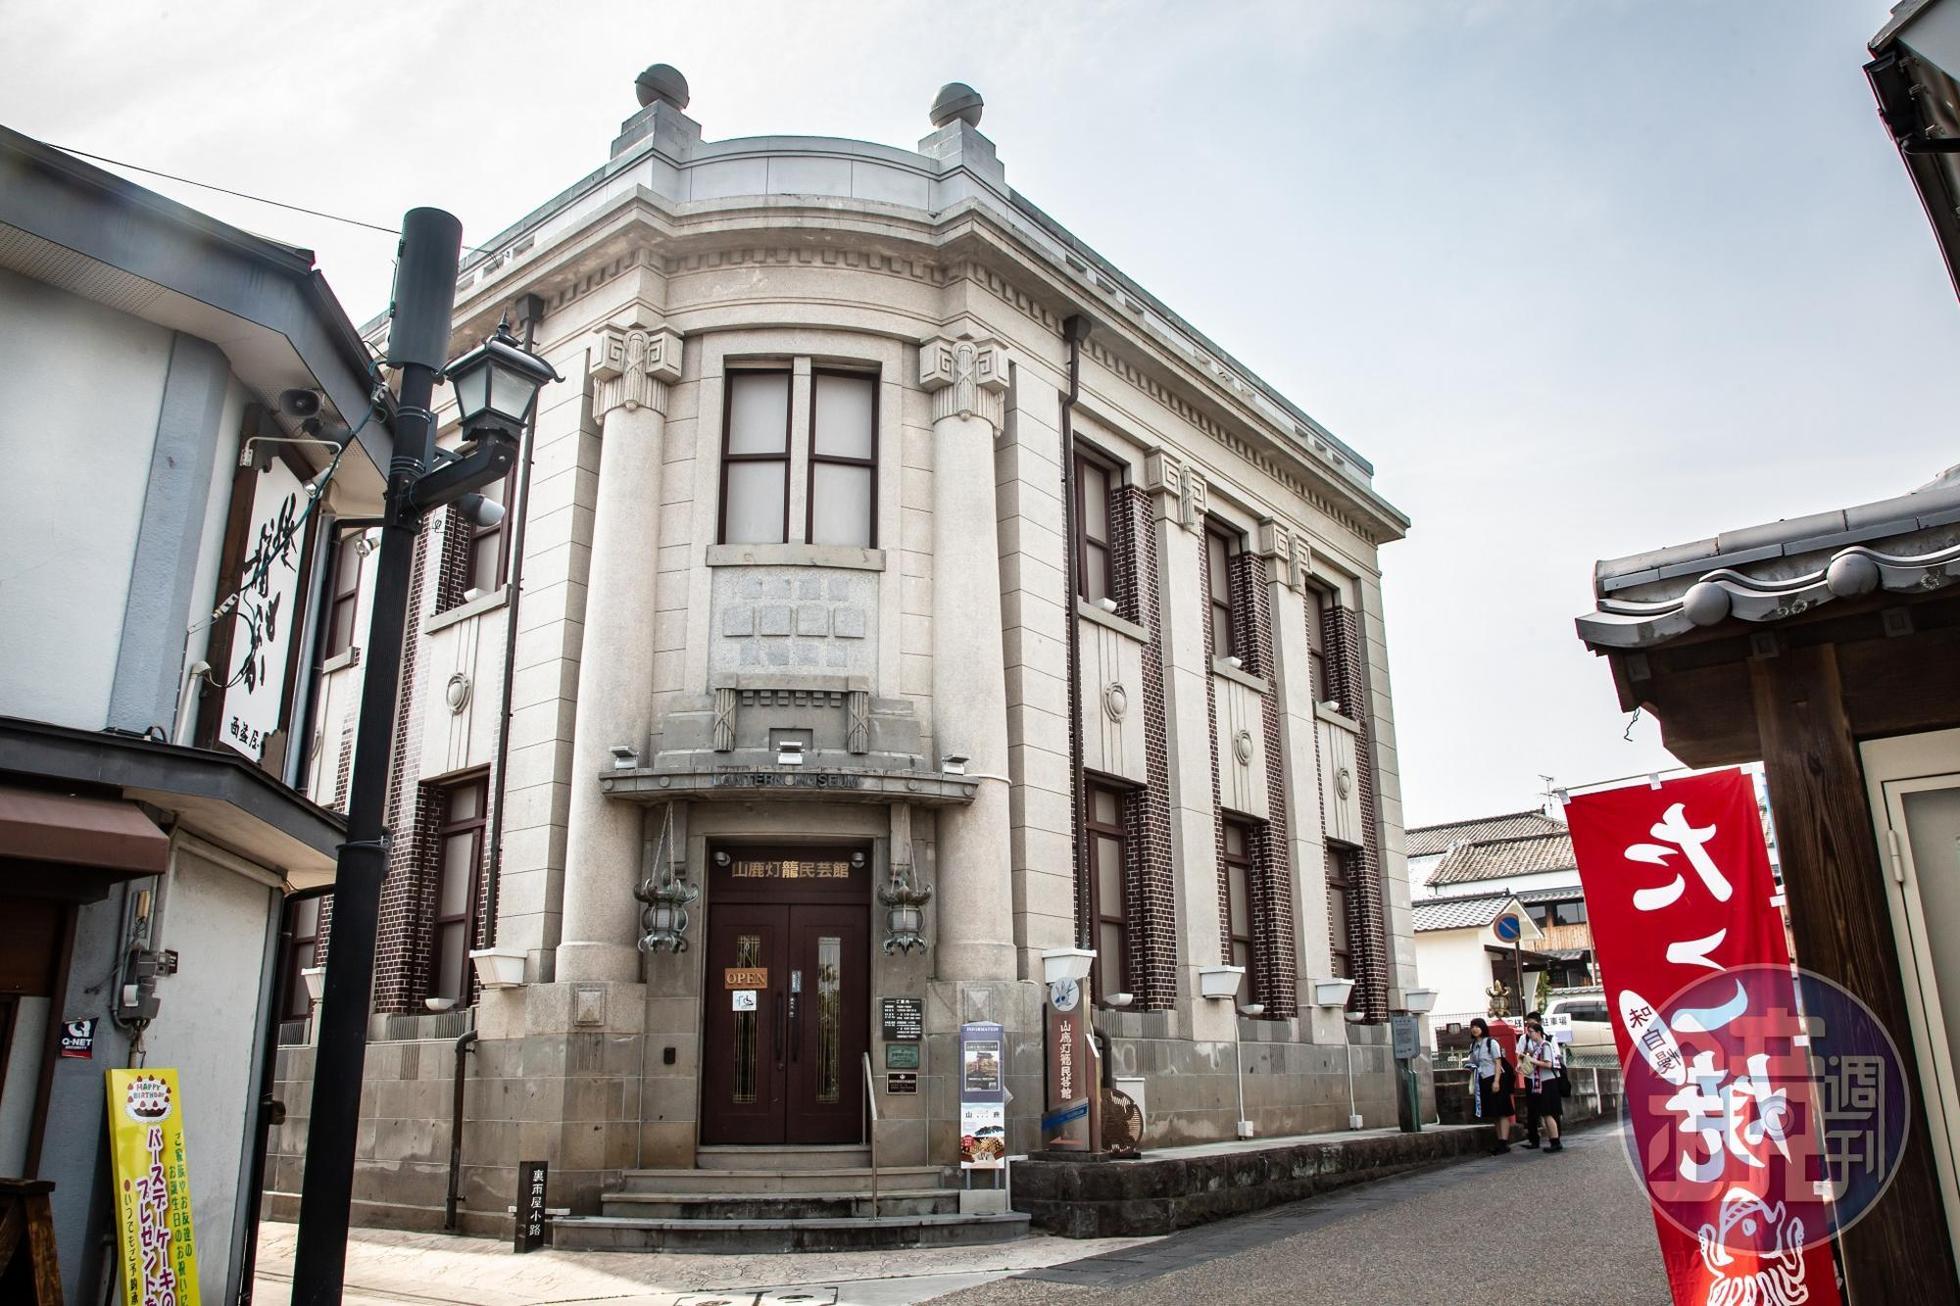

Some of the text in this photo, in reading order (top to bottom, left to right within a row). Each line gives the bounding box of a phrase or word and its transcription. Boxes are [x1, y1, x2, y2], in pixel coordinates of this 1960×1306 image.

[732, 861, 850, 878] 山鹿灯籠民芸館
[726, 972, 767, 985] OPEN
[62, 1037, 92, 1046] Q-NET
[1060, 1020, 1072, 1100] 山鹿灯籠民芸館
[136, 1083, 161, 1091] HAPPY
[133, 1091, 165, 1099] BIRTHDAY
